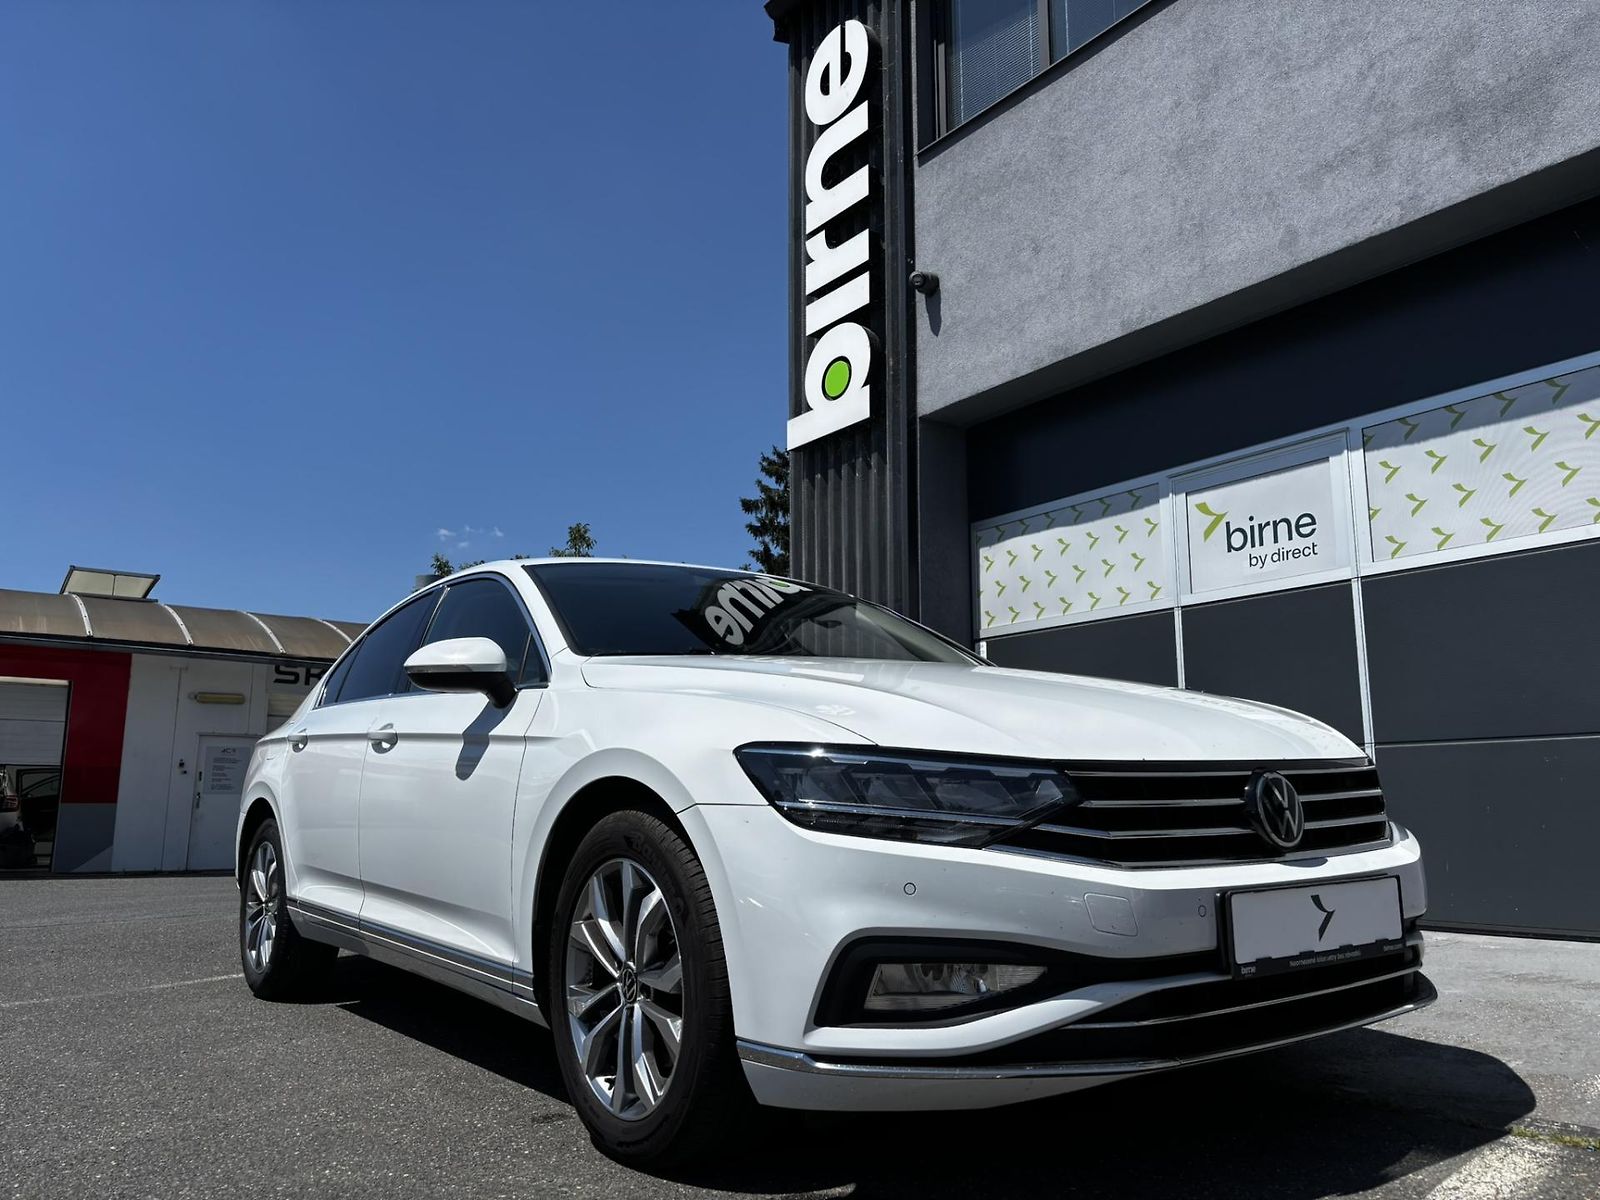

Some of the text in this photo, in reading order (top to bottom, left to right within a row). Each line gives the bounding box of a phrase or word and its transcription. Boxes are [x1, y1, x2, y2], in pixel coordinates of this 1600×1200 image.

[787, 19, 871, 451] birne
[1225, 512, 1317, 553] birne
[1249, 542, 1318, 569] by direct
